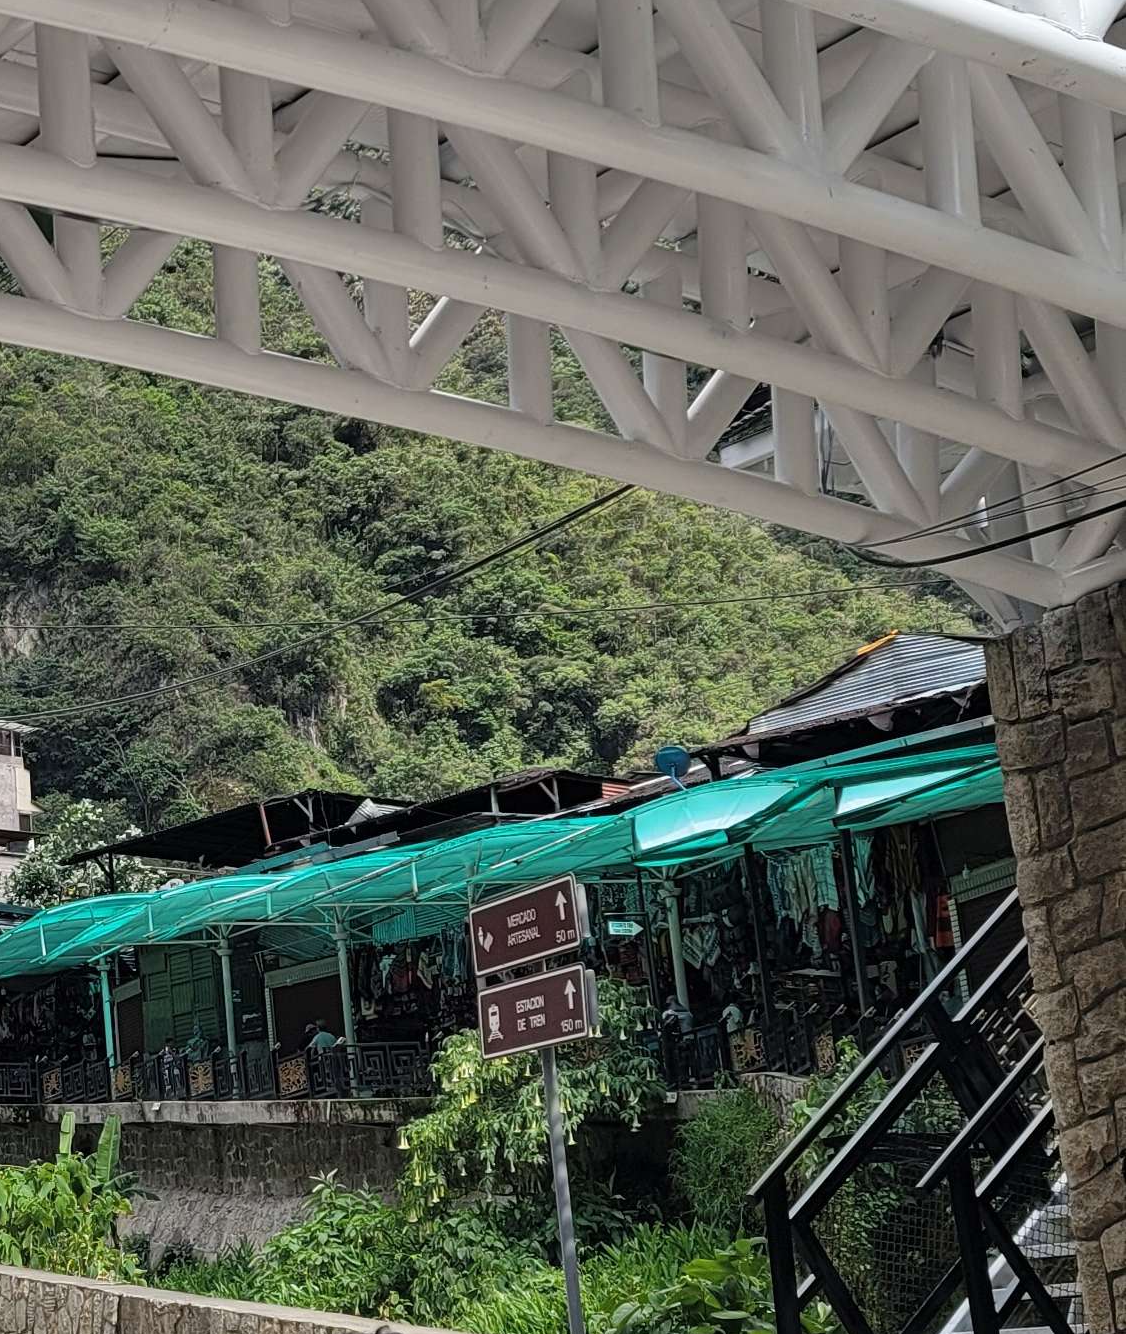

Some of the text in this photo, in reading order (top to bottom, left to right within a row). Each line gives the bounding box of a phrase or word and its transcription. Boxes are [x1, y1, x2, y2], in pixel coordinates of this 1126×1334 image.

[507, 908, 536, 928] MERCADO
[507, 926, 541, 947] ARTESANAL
[556, 929, 575, 943] 50 m
[516, 995, 545, 1013] ESTACION
[517, 1014, 546, 1032] DE TREN
[560, 1018, 583, 1033] 150 m
